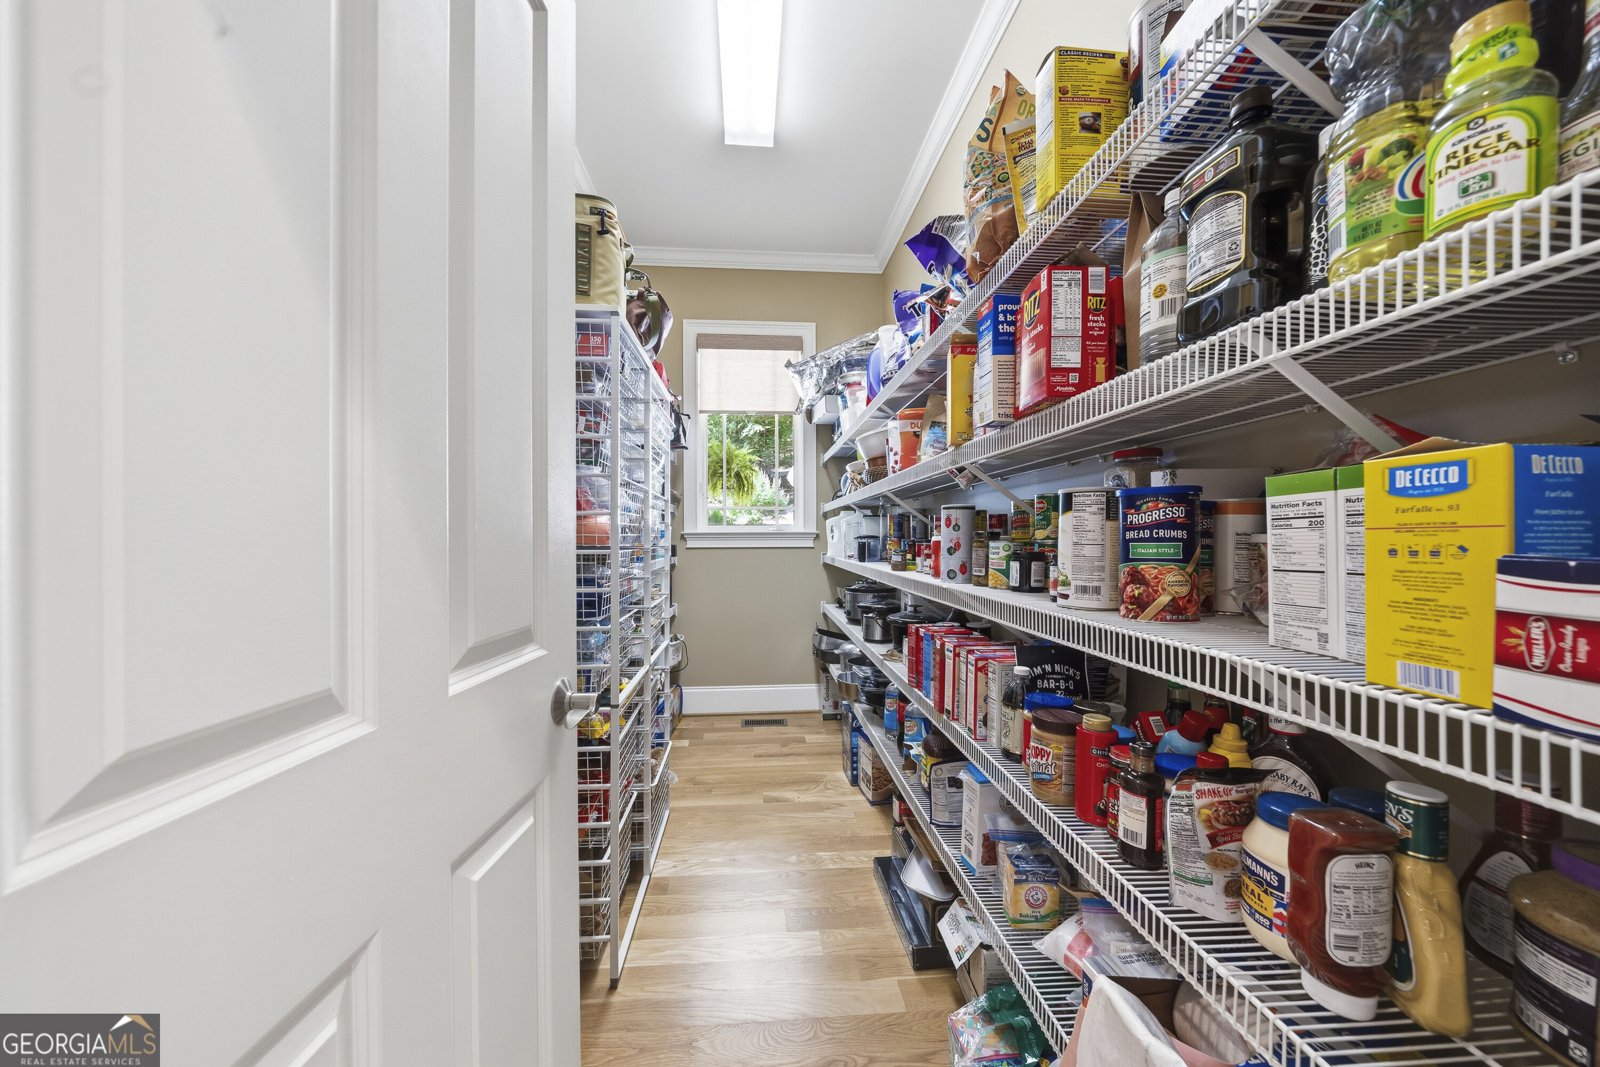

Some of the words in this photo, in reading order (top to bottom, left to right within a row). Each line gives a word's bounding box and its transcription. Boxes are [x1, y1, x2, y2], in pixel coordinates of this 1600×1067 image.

[1445, 131, 1512, 164] RICE
[1429, 138, 1541, 184] VINEGAR
[1023, 289, 1040, 326] RITZ
[1087, 295, 1106, 309] RITZ
[998, 313, 1005, 321] &
[1395, 470, 1413, 489] DE
[1414, 466, 1459, 487] CECCO
[1127, 506, 1185, 525] PROGRESSO
[1395, 505, 1433, 514] Farfalle
[1126, 531, 1150, 539] BREAD
[1153, 529, 1187, 539] CRUMBS
[1527, 621, 1547, 667] MUELLER'S
[1054, 663, 1081, 679] NICK'S
[1037, 680, 1074, 690] BAR-B-Q
[1195, 787, 1223, 800] SHAKE
[1291, 779, 1315, 799] RAY'S
[1355, 862, 1375, 870] HEINZ
